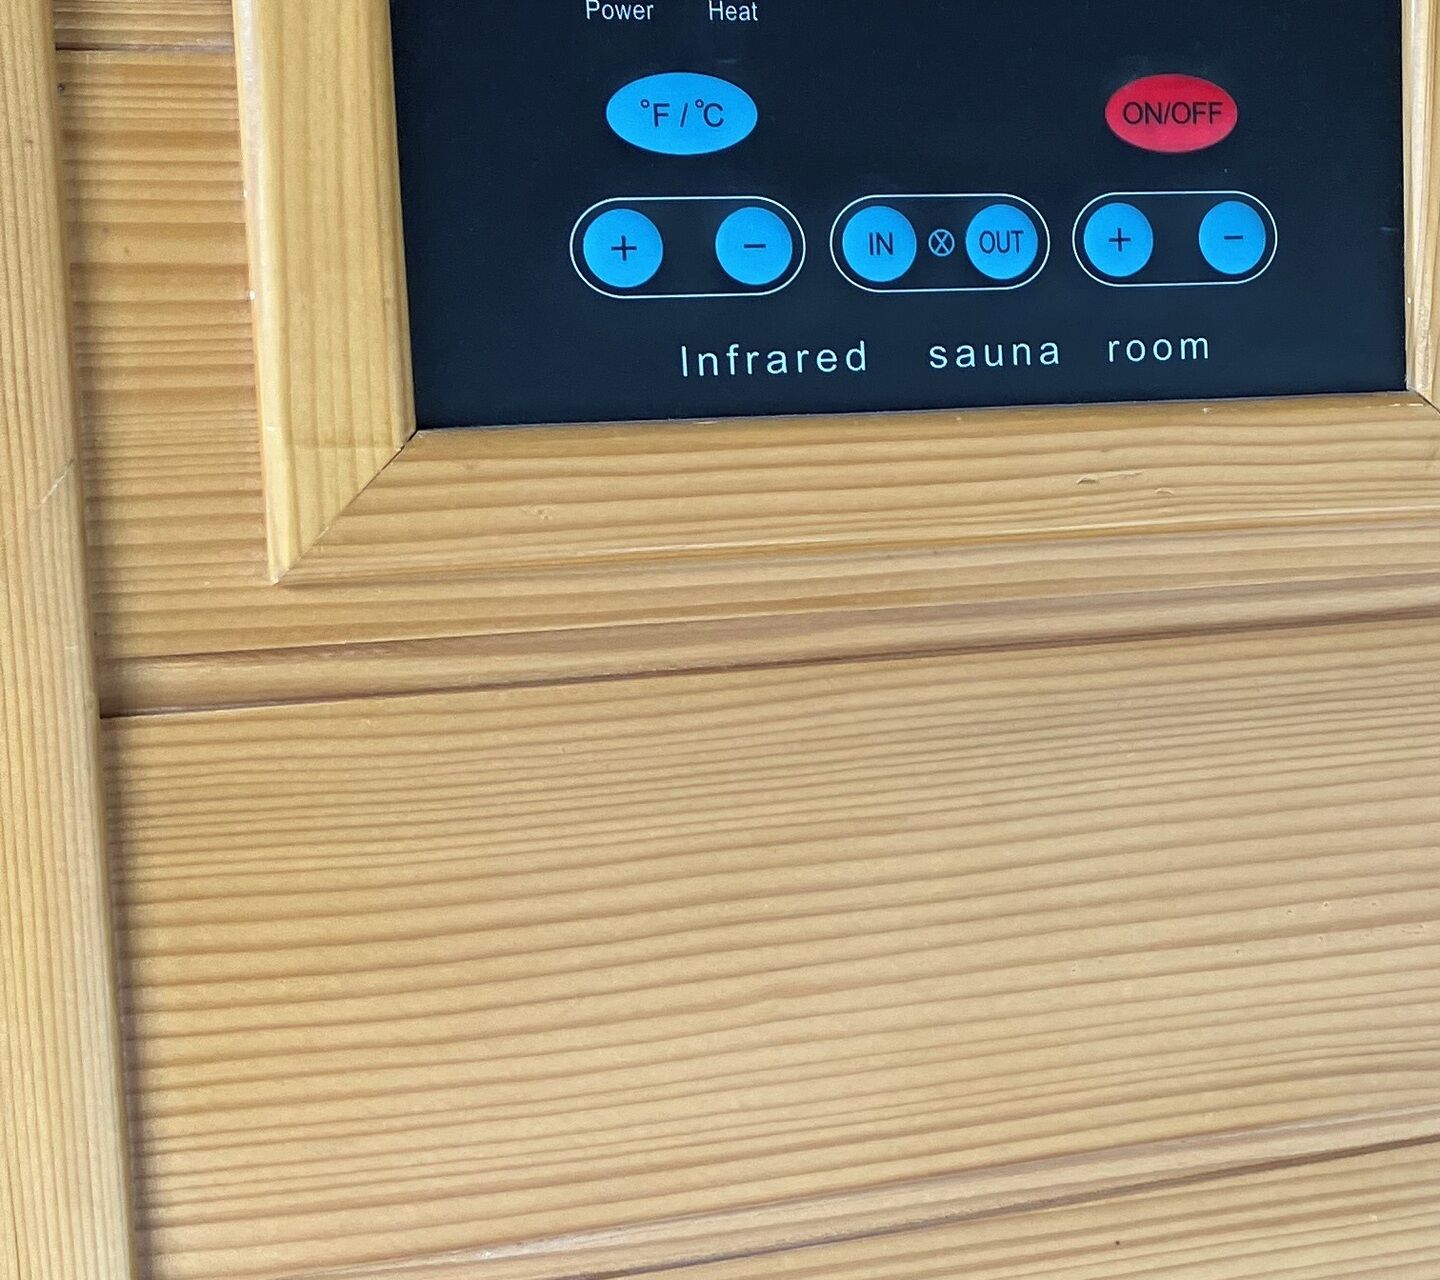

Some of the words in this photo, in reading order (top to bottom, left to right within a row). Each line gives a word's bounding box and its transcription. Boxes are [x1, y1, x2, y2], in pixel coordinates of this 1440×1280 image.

[708, 0, 759, 22] Heat
[1122, 100, 1224, 125] ON/OFF
[869, 231, 894, 256] IN
[978, 229, 1025, 255] OUT
[681, 340, 866, 377] Infrared
[929, 342, 1059, 369] sauna
[1108, 337, 1209, 363] room
